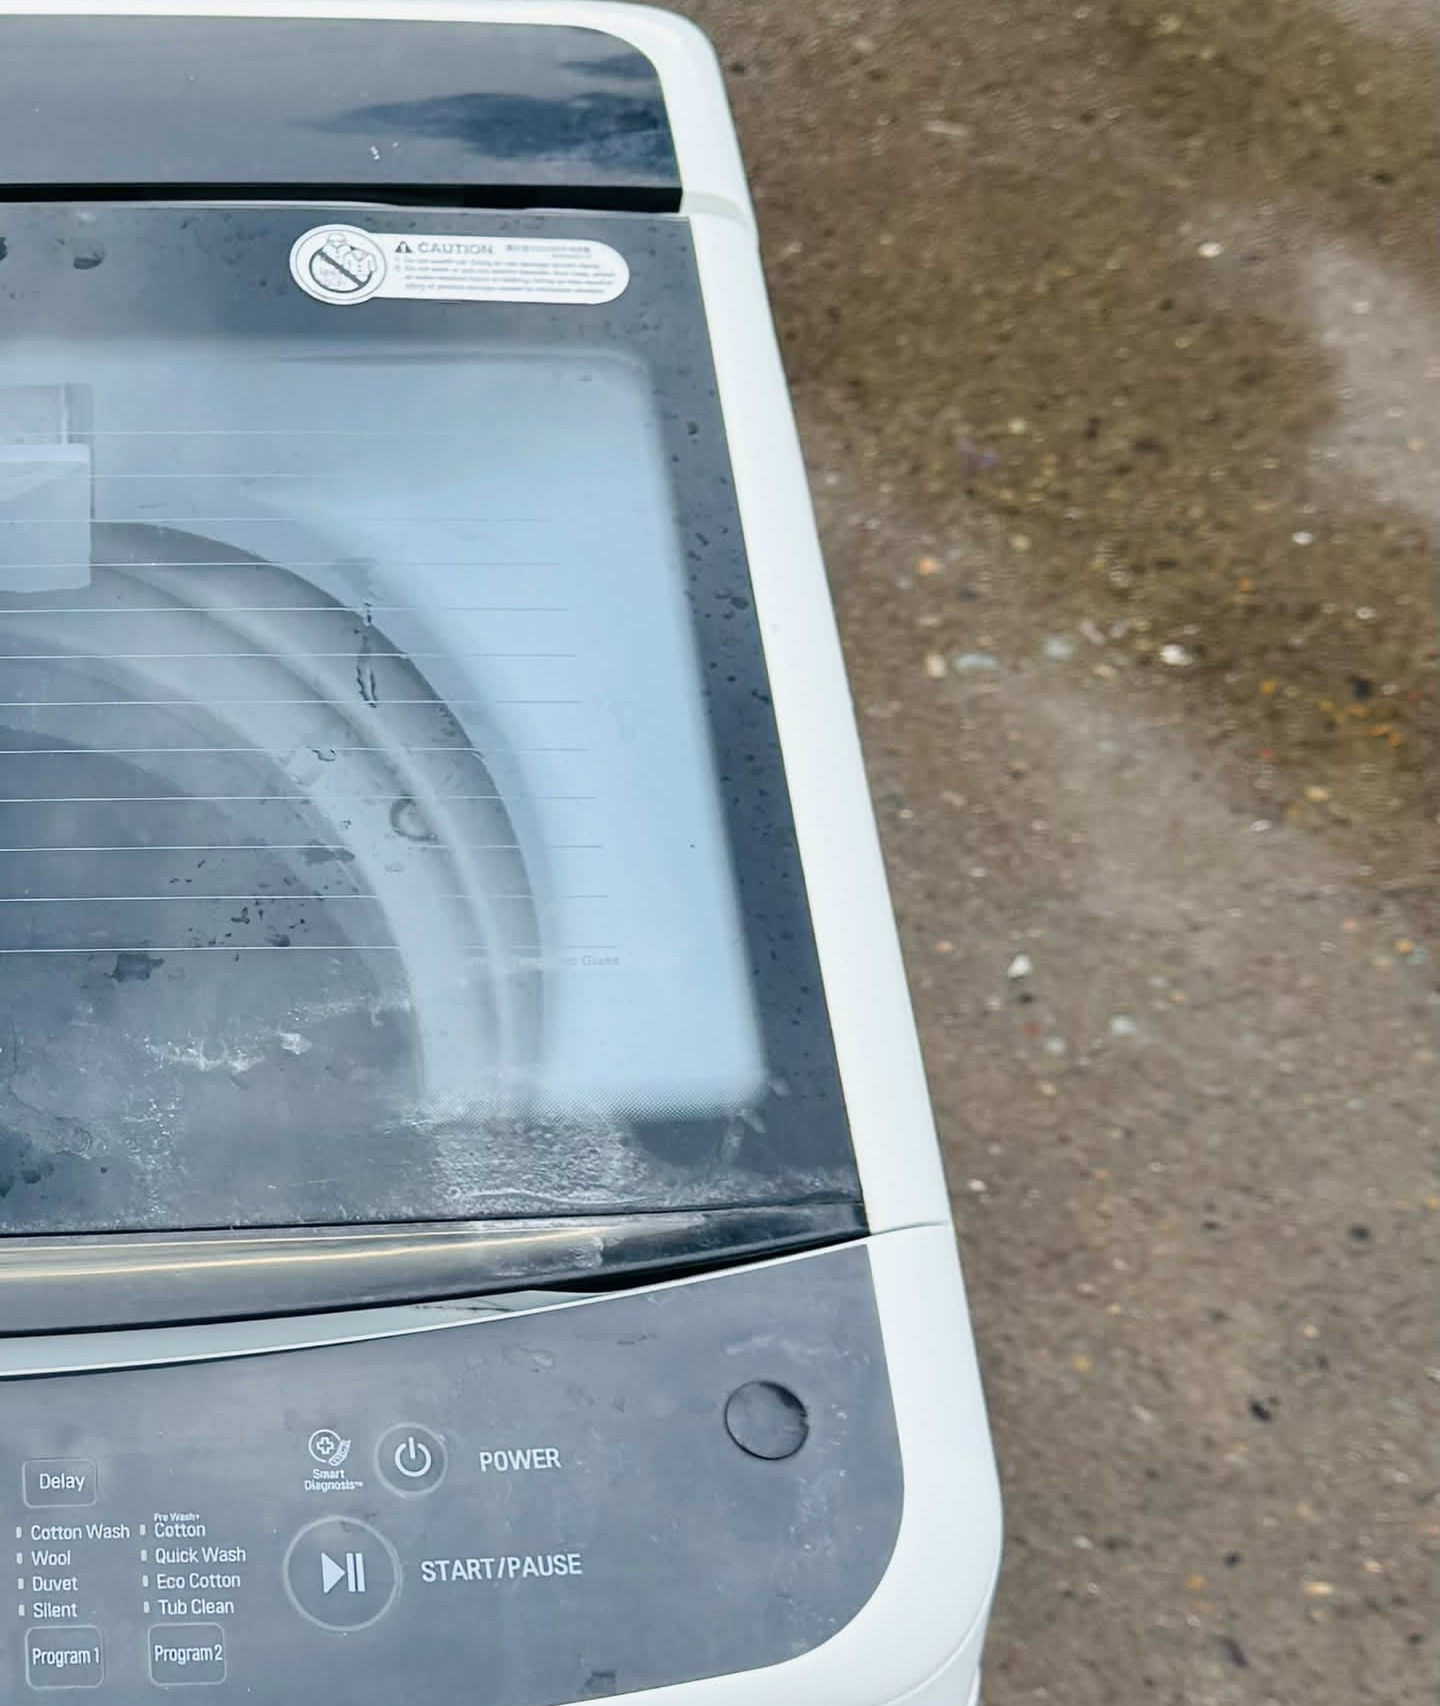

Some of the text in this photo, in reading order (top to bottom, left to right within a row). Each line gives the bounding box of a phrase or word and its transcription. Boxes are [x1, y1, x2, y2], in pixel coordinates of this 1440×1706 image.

[418, 240, 494, 255] CAUTION
[479, 1448, 561, 1472] POWER
[38, 1473, 86, 1492] Delay
[312, 1468, 345, 1480] Smart
[31, 1523, 131, 1541] Cotton Wash
[154, 1522, 206, 1538] Cotton
[31, 1550, 71, 1566] Wool
[155, 1546, 247, 1565] Quick Wash
[420, 1552, 583, 1583] START/PAUSE
[32, 1575, 79, 1592] Duvet
[157, 1573, 241, 1590] Eco Cotton
[33, 1601, 78, 1619] Silent
[158, 1598, 235, 1615] Tub Clean
[32, 1646, 91, 1668] Program
